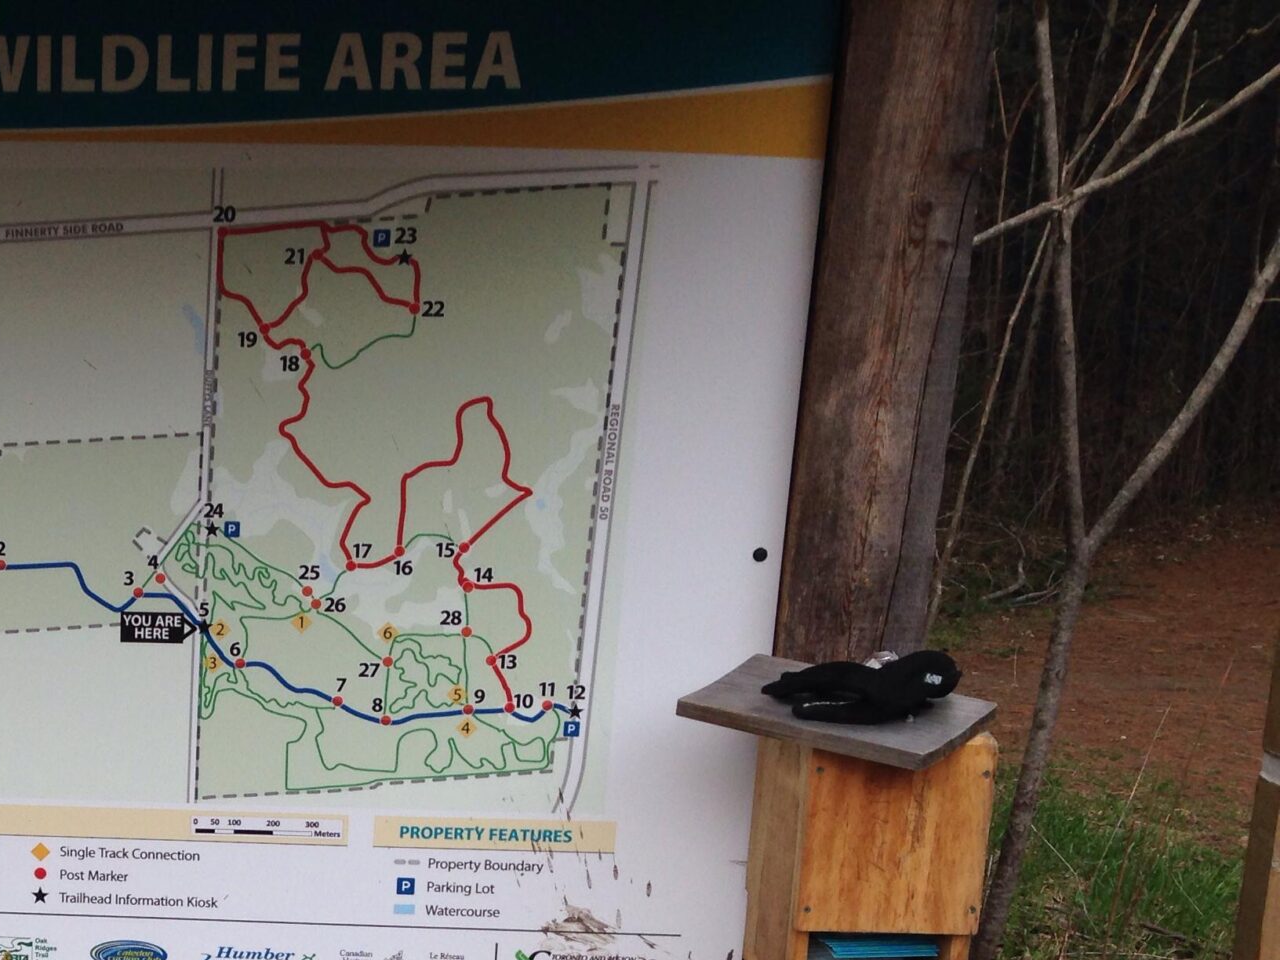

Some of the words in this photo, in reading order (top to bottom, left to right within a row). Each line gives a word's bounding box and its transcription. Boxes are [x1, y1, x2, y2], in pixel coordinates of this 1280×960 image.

[323, 31, 522, 91] AREA
[213, 206, 236, 222] 20
[4, 226, 60, 240] FINNERTY
[62, 224, 88, 236] SIDE
[90, 222, 124, 234] ROAD
[394, 227, 418, 244] 23
[284, 248, 305, 264] 21
[422, 301, 445, 318] 22
[280, 356, 300, 372] 18
[605, 404, 620, 466] REGIONAL
[601, 469, 615, 503] ROAD
[204, 503, 224, 518] 24
[598, 506, 609, 520] 50
[353, 544, 372, 558] 17
[298, 565, 320, 580] 25
[474, 568, 494, 582] 14
[324, 598, 346, 612] 26
[123, 614, 152, 627] YOU
[155, 615, 182, 628] ARE
[440, 610, 462, 626] 28
[134, 628, 170, 640] HERE
[498, 654, 518, 670] 13
[400, 826, 484, 840] PROPERTY
[489, 828, 572, 844] FEATURES
[60, 846, 96, 860] Single
[98, 847, 129, 859] Track
[132, 848, 200, 861] Connection
[428, 858, 481, 873] Property
[484, 859, 544, 876] Boundary
[60, 869, 84, 880] Post
[88, 870, 128, 882] Marker
[427, 881, 472, 896] Parking
[476, 883, 494, 894] Lot
[59, 892, 112, 904] Trailhead
[116, 894, 183, 906] Information
[187, 897, 218, 908] Kiosk
[426, 905, 500, 918] Watercourse
